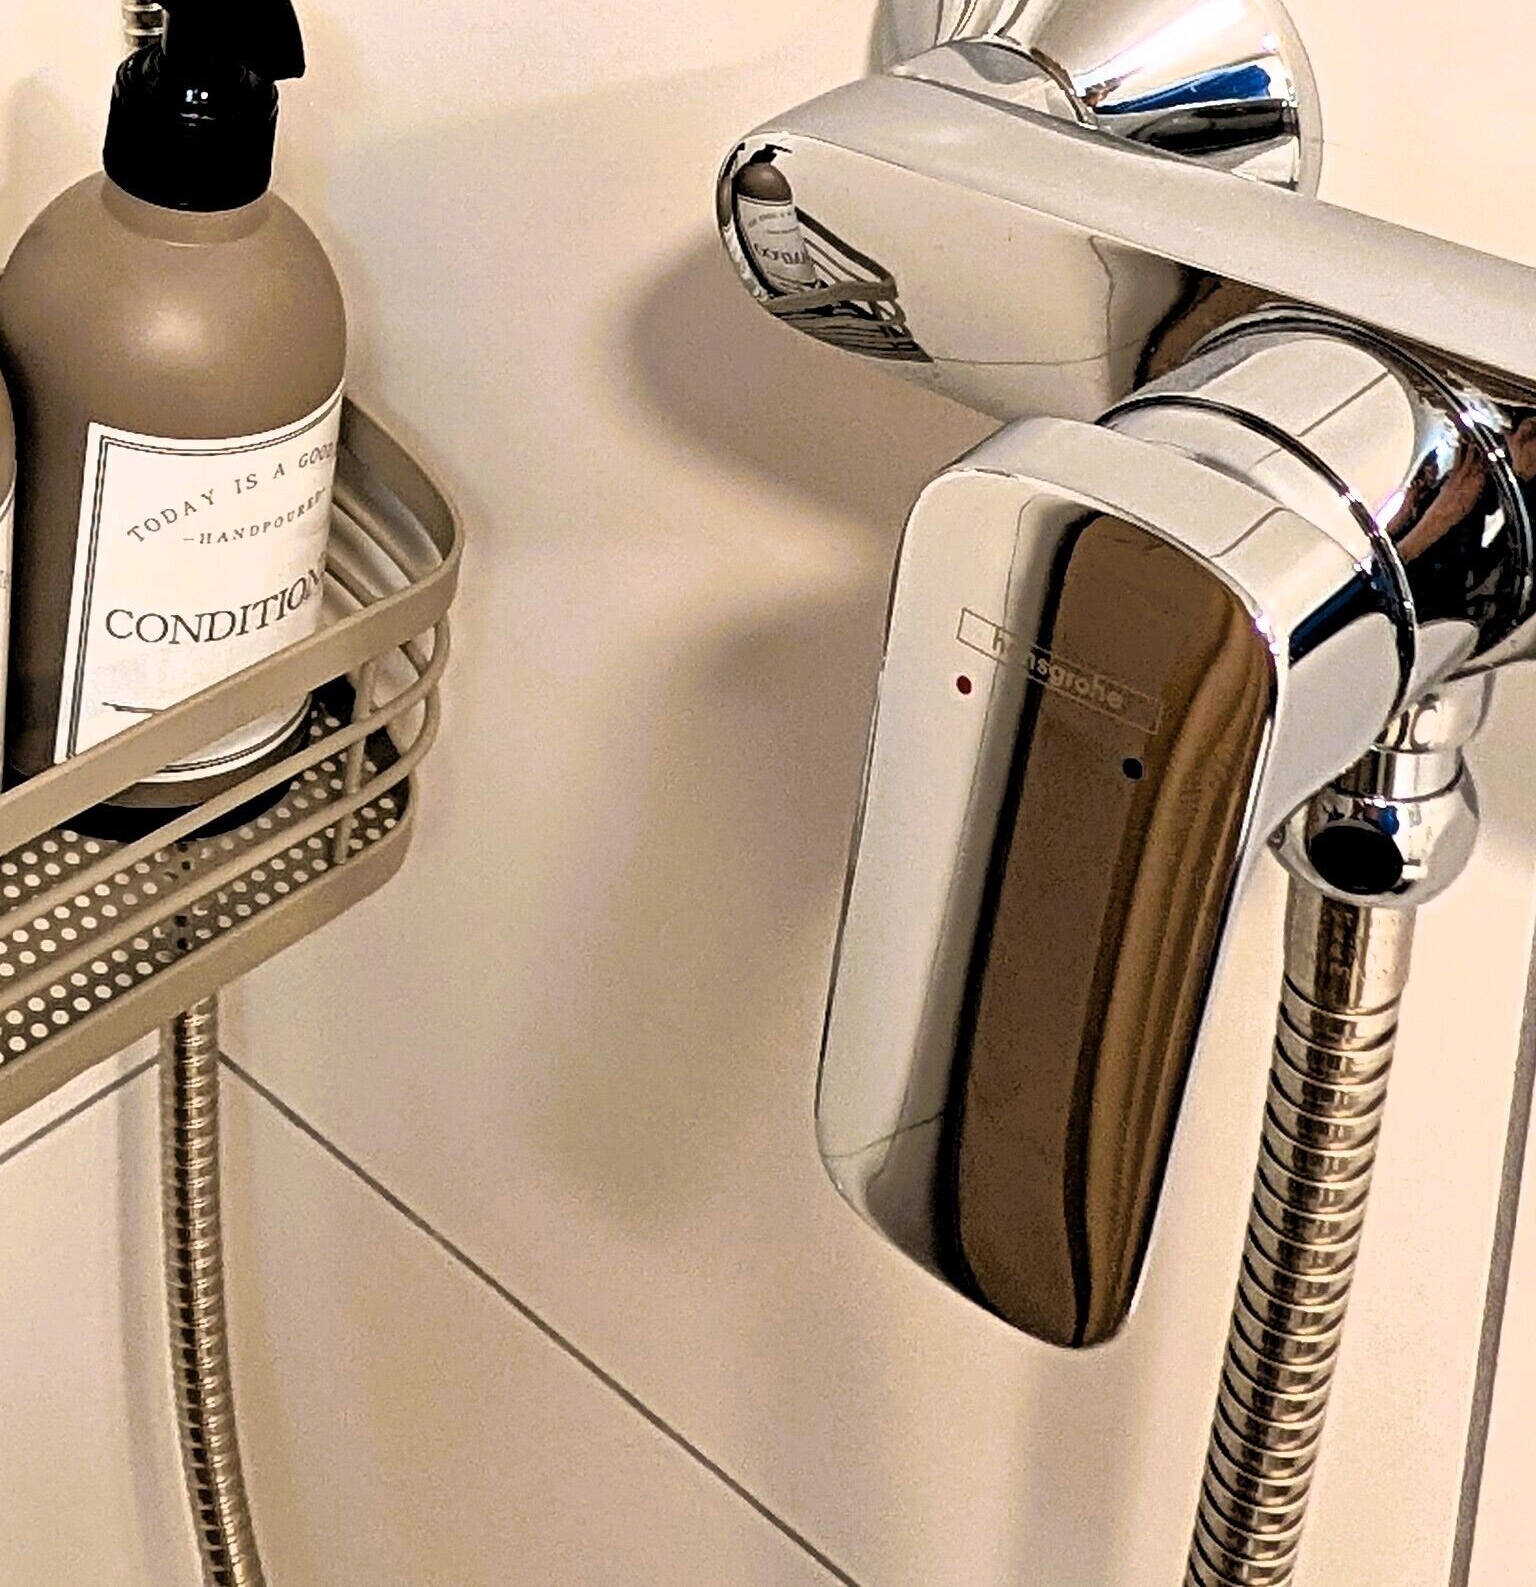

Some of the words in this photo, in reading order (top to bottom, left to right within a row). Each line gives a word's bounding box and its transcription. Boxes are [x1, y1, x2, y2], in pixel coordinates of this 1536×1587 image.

[126, 488, 216, 544] TODAY
[233, 472, 259, 495] IS
[272, 462, 286, 480] A
[104, 567, 324, 646] CONDITION
[991, 626, 1124, 709] hnsgrohe
